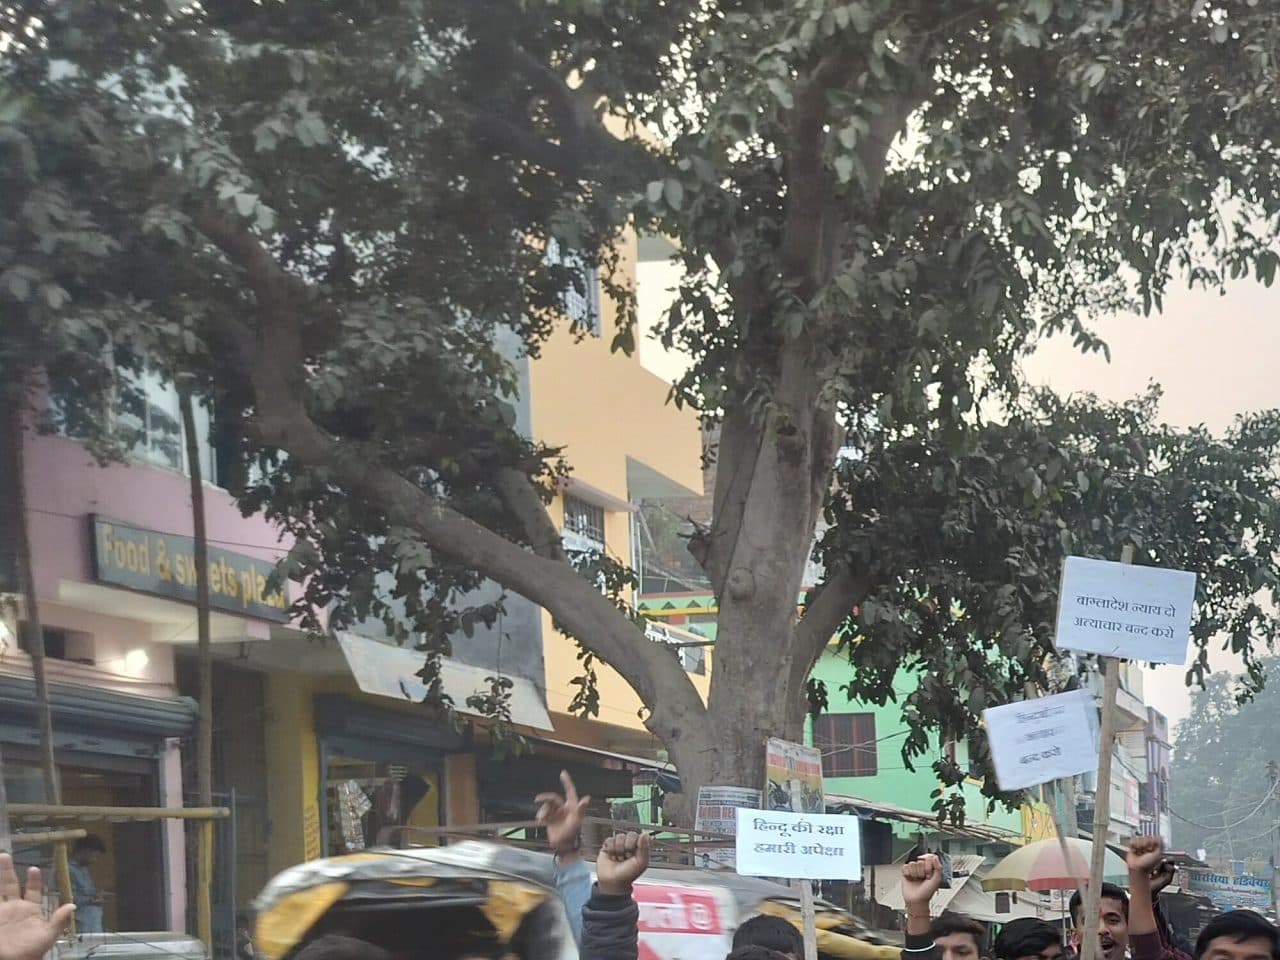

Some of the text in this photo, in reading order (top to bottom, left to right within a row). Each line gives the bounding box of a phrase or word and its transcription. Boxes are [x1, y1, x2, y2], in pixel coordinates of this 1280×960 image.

[101, 522, 150, 576] Food
[155, 537, 172, 582] &
[176, 553, 238, 598] swets
[1132, 603, 1161, 616] न्याय
[1164, 604, 1176, 618] दो
[1151, 626, 1174, 639] करो
[753, 818, 791, 837] हिन्दू
[816, 825, 845, 836] रक्षा
